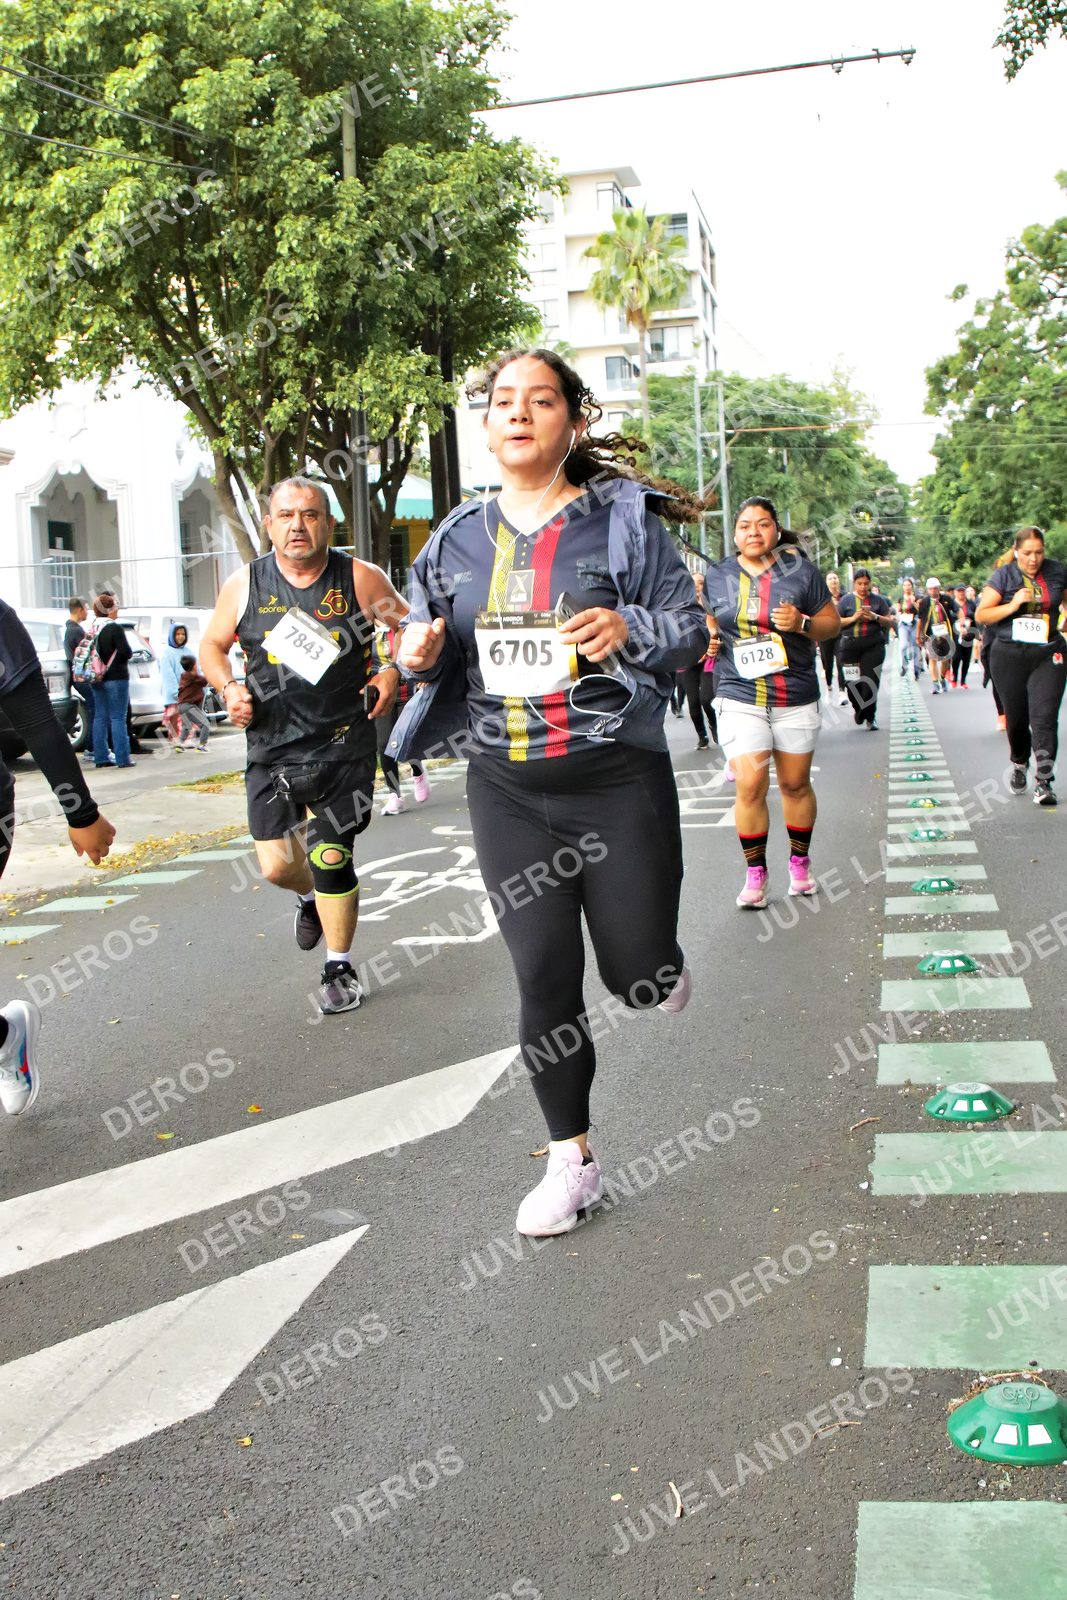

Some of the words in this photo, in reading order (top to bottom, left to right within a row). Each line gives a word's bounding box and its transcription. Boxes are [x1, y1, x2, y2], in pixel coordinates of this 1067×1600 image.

[284, 625, 324, 660] 7843
[489, 640, 553, 666] 6705
[740, 647, 774, 665] 6128
